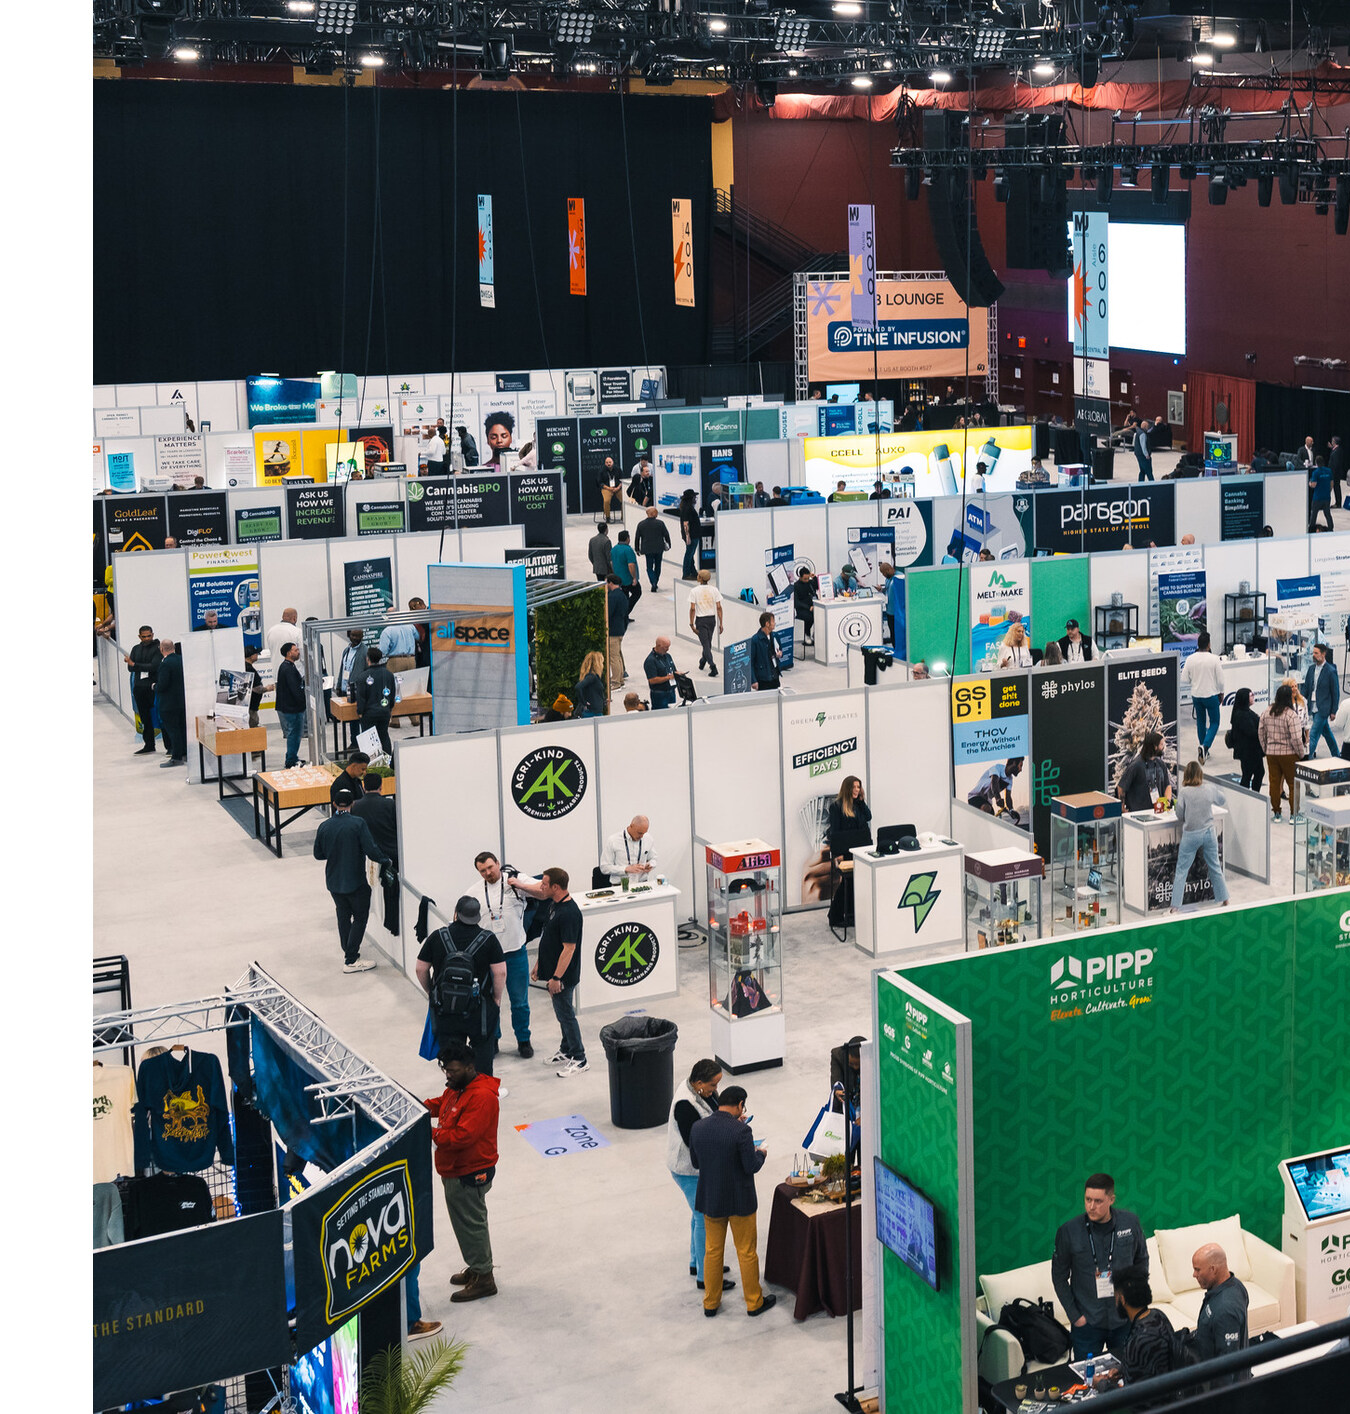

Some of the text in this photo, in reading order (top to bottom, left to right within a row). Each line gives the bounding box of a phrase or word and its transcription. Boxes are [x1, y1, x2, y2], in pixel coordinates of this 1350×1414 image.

[684, 222, 692, 278] 400
[866, 231, 874, 296] 500
[1098, 243, 1106, 319] 600
[886, 293, 944, 306] LOUNGE
[704, 422, 738, 431] FundCanna
[711, 449, 733, 458] HANS
[831, 449, 863, 457] CCELL
[876, 446, 905, 454] AUXO
[299, 491, 316, 499] ASK
[426, 483, 500, 496] CannabisBPO
[296, 500, 318, 508] HOW
[518, 494, 554, 502] MITIGATE
[114, 508, 157, 518] GoldLeaf
[526, 502, 546, 510] COST
[887, 507, 910, 519] PAI
[1061, 498, 1150, 528] paragon
[968, 513, 983, 527] ATM
[1063, 528, 1087, 536] HIGHER
[192, 549, 252, 560] PowerQwest
[353, 572, 383, 580] CANNASPIRE
[977, 588, 1023, 600] MELT MAKE
[436, 622, 510, 641] allspace
[848, 622, 861, 637] G
[1118, 666, 1167, 681] ELITE SEEDS
[955, 686, 987, 702] GS
[1002, 685, 1017, 694] get
[1061, 679, 1096, 694] phylos
[999, 700, 1020, 709] done
[828, 712, 858, 720] REBATES
[974, 727, 1008, 738] THCV
[961, 735, 1021, 750] Energy Without
[966, 743, 1016, 755] the Munchies
[795, 739, 855, 766] EFFICIENCY
[515, 750, 564, 790] AGRI-KIND
[519, 759, 574, 803] AK
[524, 760, 585, 818] PREMIUM CANNABIS PRODUCTS
[737, 853, 772, 870] Alibi
[598, 925, 639, 961] AGRI-KIND
[601, 932, 648, 974] AK
[604, 933, 657, 984] PREMIUM CANNABIS PRODUCTS
[1087, 948, 1153, 984] PIPP
[1050, 977, 1153, 1004] HORTICULTURE
[912, 1008, 928, 1025] PIPP
[544, 1125, 598, 1156] Zone G
[337, 1182, 394, 1230] SETTING THE STANDARD
[329, 1192, 406, 1278] nova
[346, 1228, 408, 1290] FARMS
[93, 1300, 204, 1338] THE STANDARD
